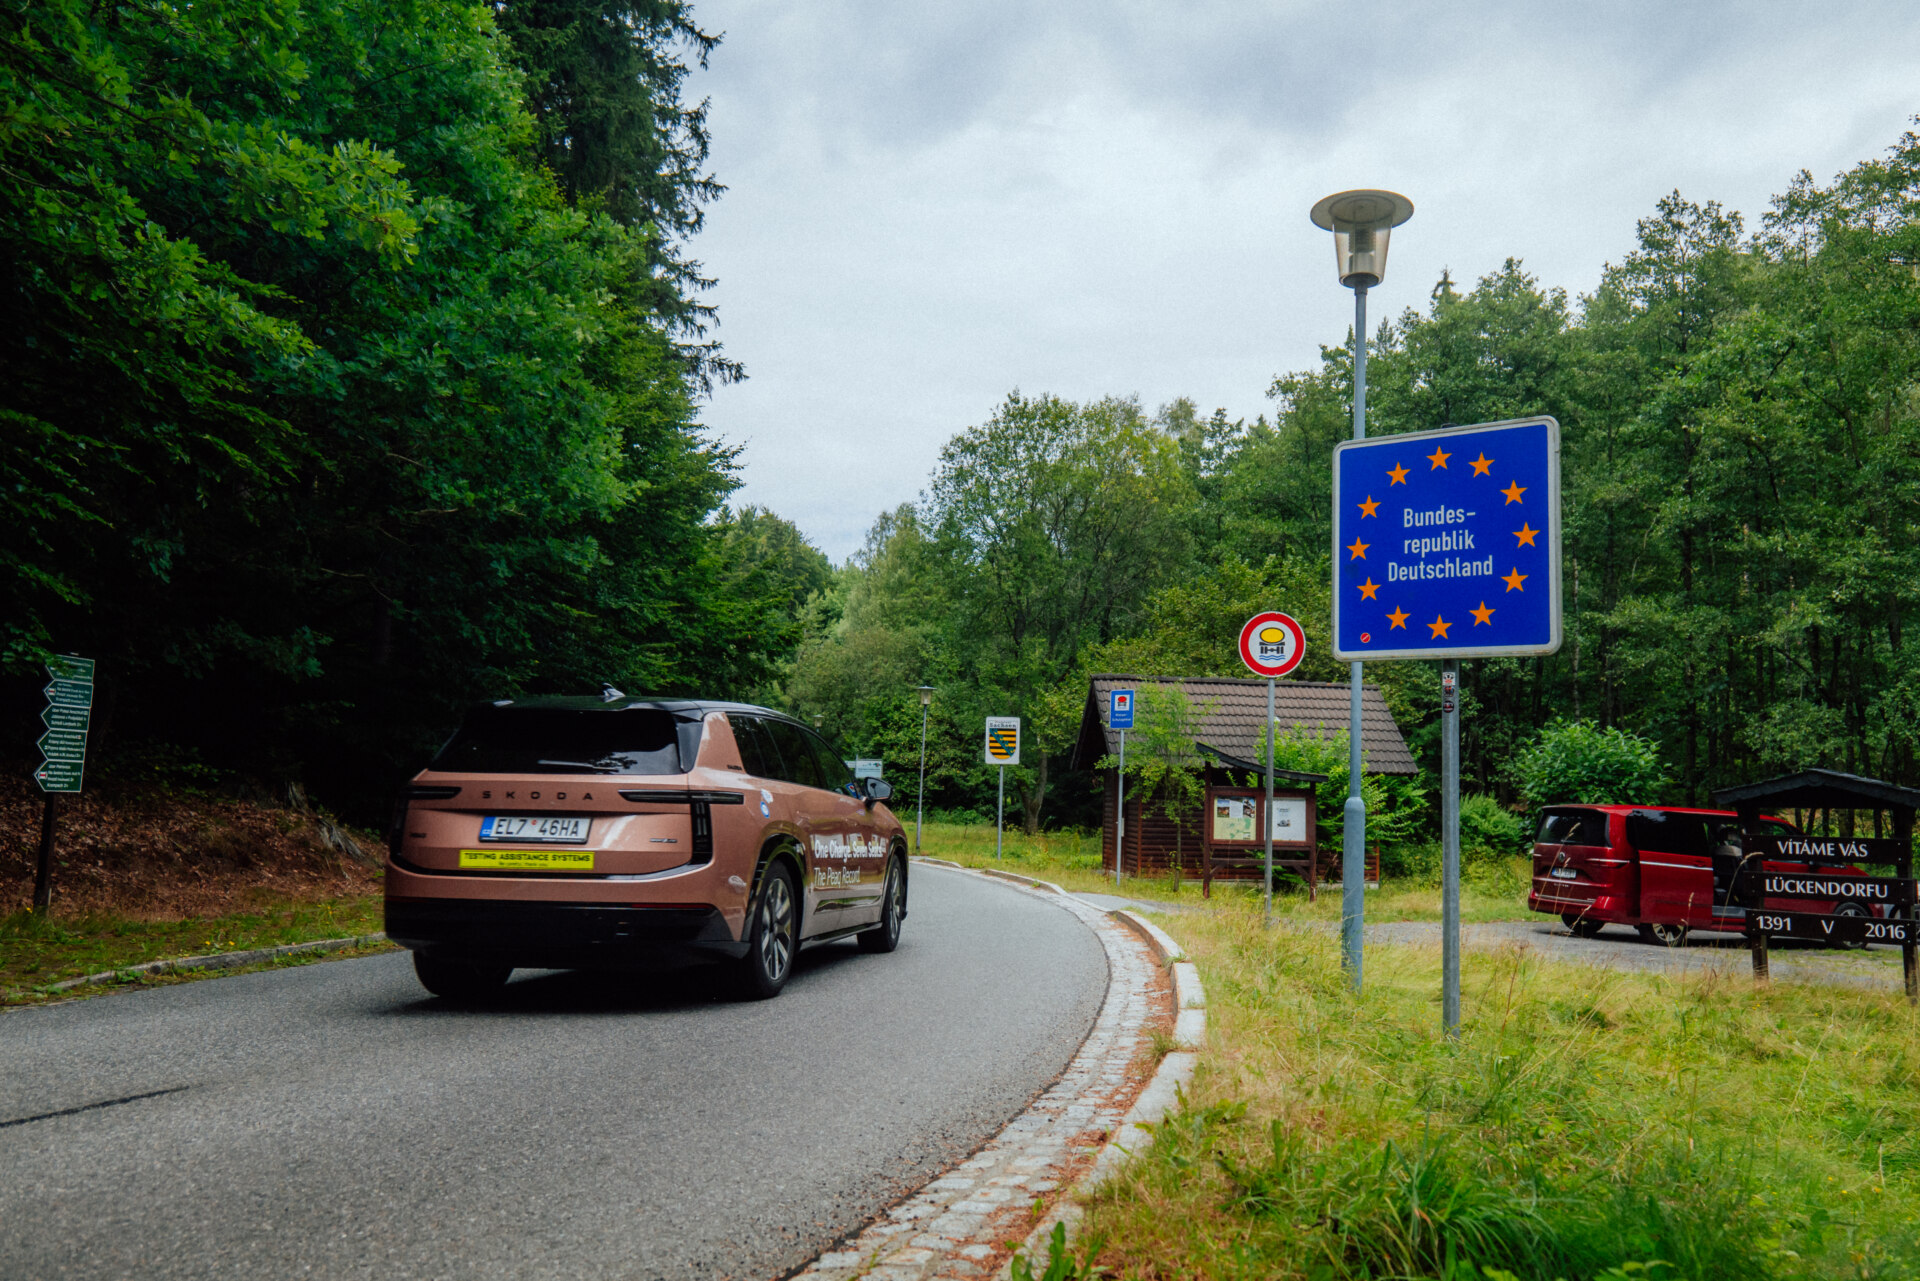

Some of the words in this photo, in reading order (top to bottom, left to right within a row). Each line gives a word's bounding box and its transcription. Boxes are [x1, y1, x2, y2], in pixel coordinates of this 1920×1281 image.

[1403, 505, 1476, 528] Bundes-
[1404, 529, 1475, 558] republik
[1388, 555, 1493, 582] Deutschland
[495, 818, 528, 835] EL7
[538, 819, 579, 837] 46HA
[464, 852, 497, 860] TESTING
[500, 853, 549, 861] ASSISTANCE
[551, 854, 590, 862] SYSTEMS
[814, 839, 828, 858] One
[852, 840, 868, 858] Seven
[1777, 838, 1835, 856] VÍTÁME
[1838, 841, 1869, 857] VÁS
[814, 867, 826, 886] The
[827, 866, 841, 888] Peaq
[842, 865, 860, 884] Record
[1765, 876, 1888, 898] LÜCKENDORFU
[1756, 915, 1791, 931] 1391
[1821, 919, 1835, 934] V
[1864, 923, 1906, 940] 2016
